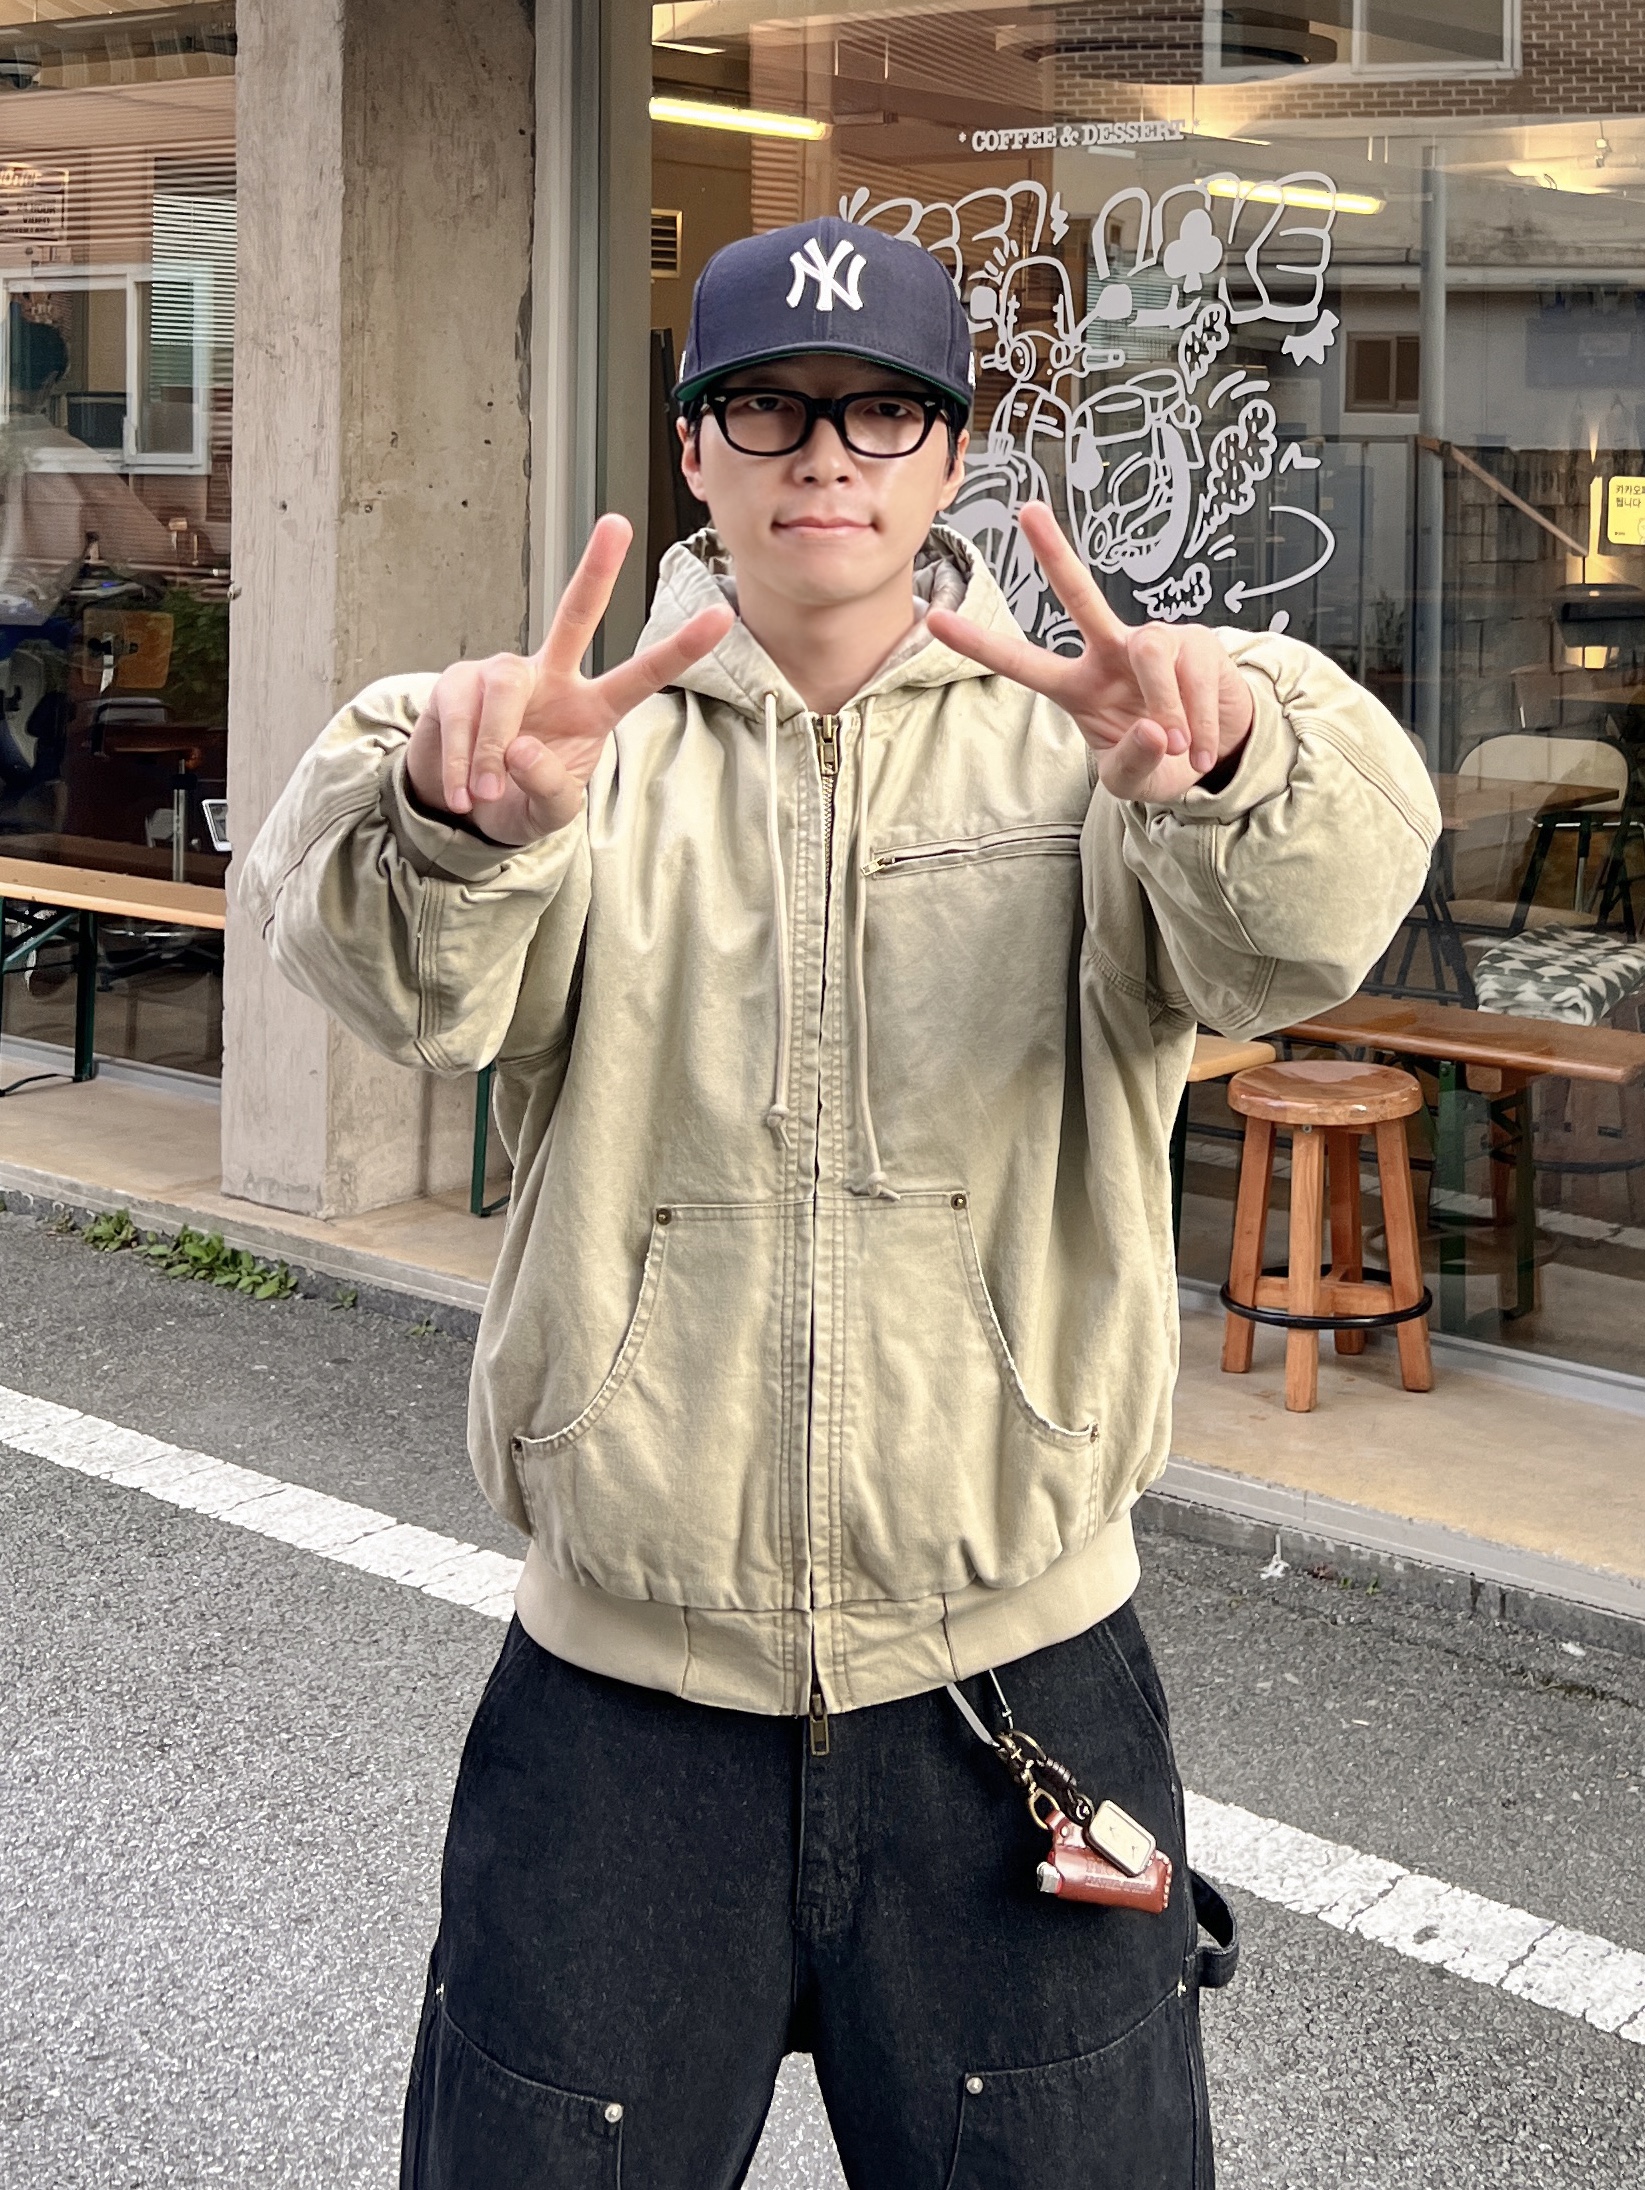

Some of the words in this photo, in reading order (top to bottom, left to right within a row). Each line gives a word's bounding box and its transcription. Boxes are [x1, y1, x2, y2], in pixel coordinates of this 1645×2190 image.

[972, 127, 1057, 152] COFFEE
[1059, 126, 1078, 147] &
[1081, 121, 1184, 145] DESSERT
